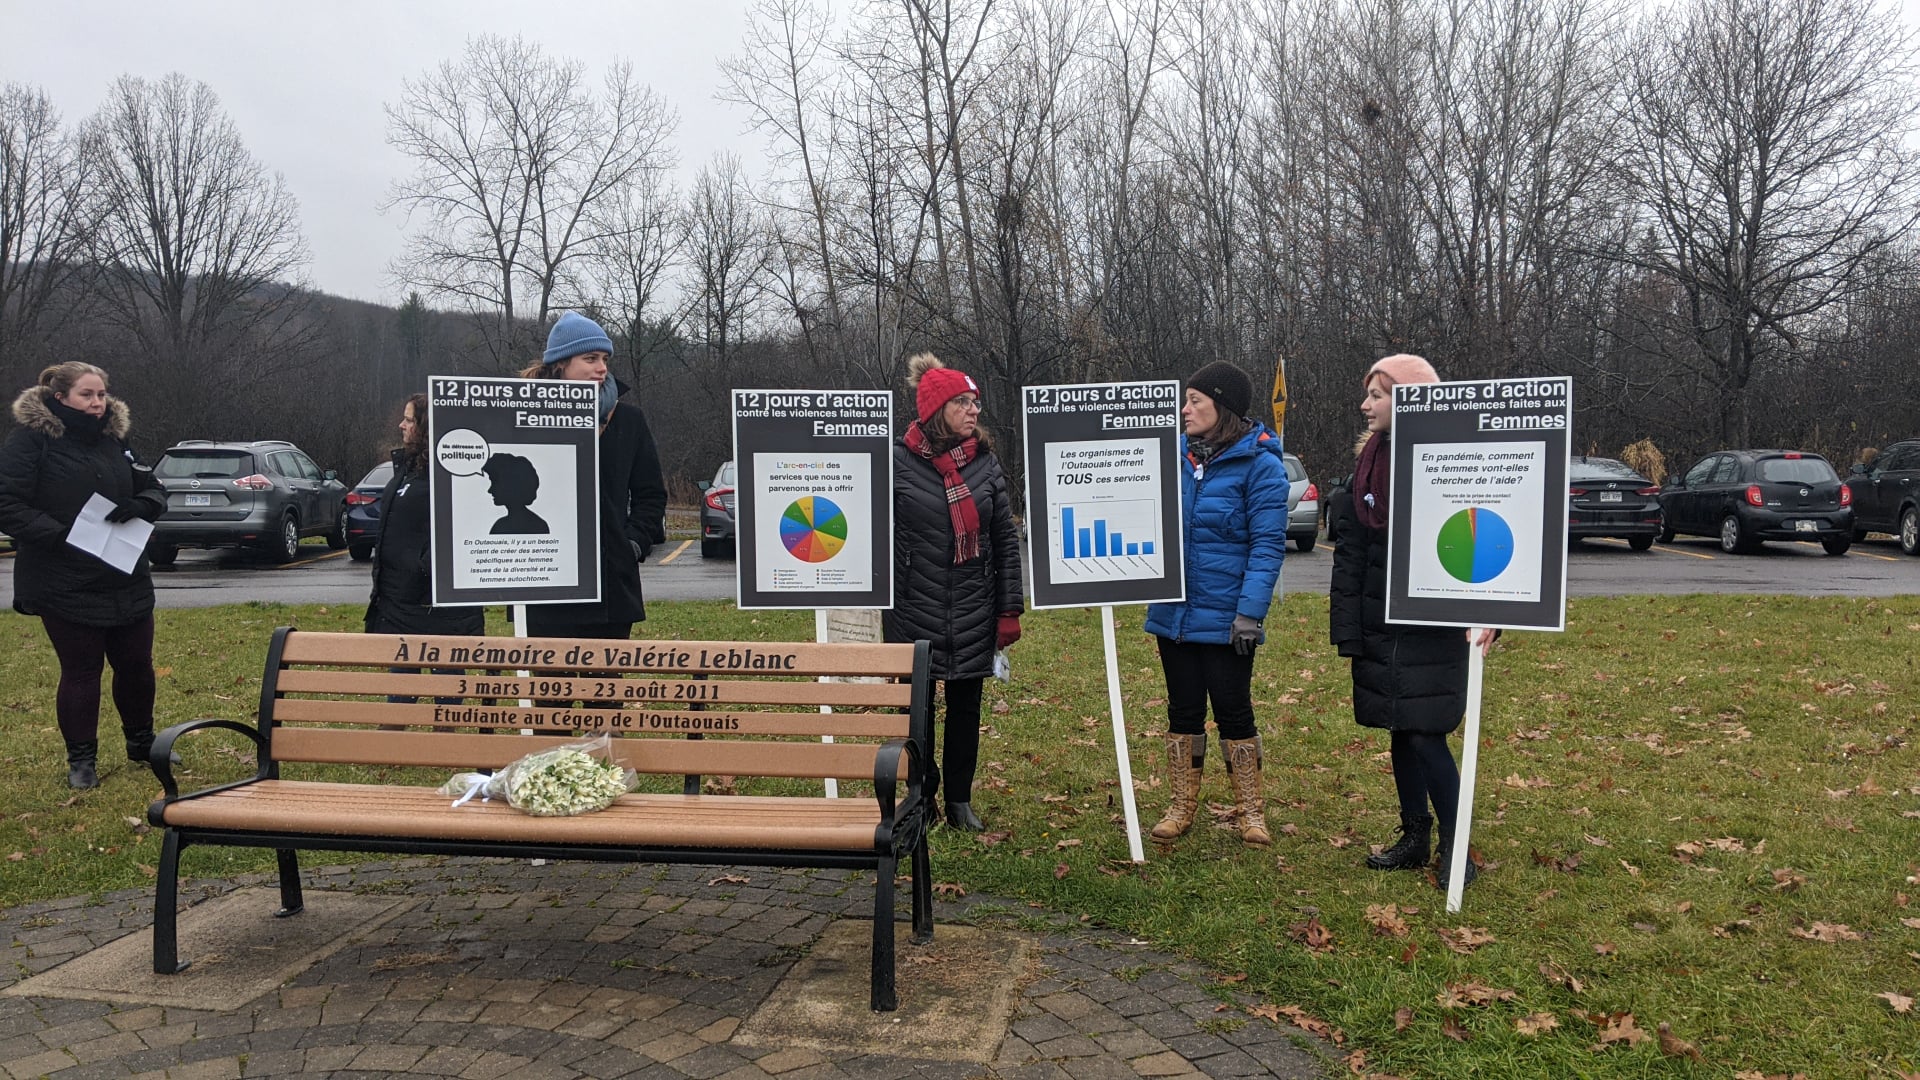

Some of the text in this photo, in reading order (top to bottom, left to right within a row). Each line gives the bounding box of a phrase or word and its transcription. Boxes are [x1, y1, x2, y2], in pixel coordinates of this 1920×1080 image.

[436, 381, 458, 396] 12
[464, 382, 513, 399] jours
[1030, 389, 1049, 403] 12
[1055, 388, 1099, 405] jours
[1400, 386, 1420, 402] 12
[1426, 385, 1476, 404] jours
[433, 398, 468, 406] contre
[472, 398, 487, 407] les
[491, 398, 541, 408] violences
[544, 400, 572, 409] faites
[739, 393, 759, 407] 12
[765, 393, 811, 410] jours
[1027, 405, 1059, 414] contre
[1062, 404, 1076, 412] les
[1079, 402, 1125, 412] violences
[1128, 400, 1154, 409] faites
[1396, 403, 1430, 412] contre
[1434, 402, 1449, 411] les
[1453, 400, 1505, 410] violences
[1509, 399, 1541, 408] faites
[516, 411, 594, 427] Femmes
[737, 409, 769, 417] contre
[772, 409, 786, 417] les
[790, 409, 837, 417] violences
[840, 409, 867, 417] faites
[1102, 413, 1175, 428] Femmes
[1478, 413, 1565, 429] Femmes
[813, 421, 888, 435] Femmes
[442, 452, 484, 461] politique!
[1079, 449, 1130, 459] organismes
[1436, 452, 1485, 462] pandémie,
[1488, 452, 1534, 460] comment
[1114, 459, 1144, 467] offrent
[1482, 464, 1529, 472] vont-elles
[1057, 473, 1093, 485] TOUS
[1114, 474, 1150, 482] services
[394, 638, 797, 670] À la mémoire de Valérie Leblanc
[458, 679, 467, 694] 3
[475, 683, 519, 696] mars
[528, 680, 573, 696] 1993
[594, 682, 616, 698] 23
[624, 681, 666, 699] août
[674, 684, 720, 700] 2011
[434, 707, 739, 730] Étudiante au Cégep de l'Outaouais
